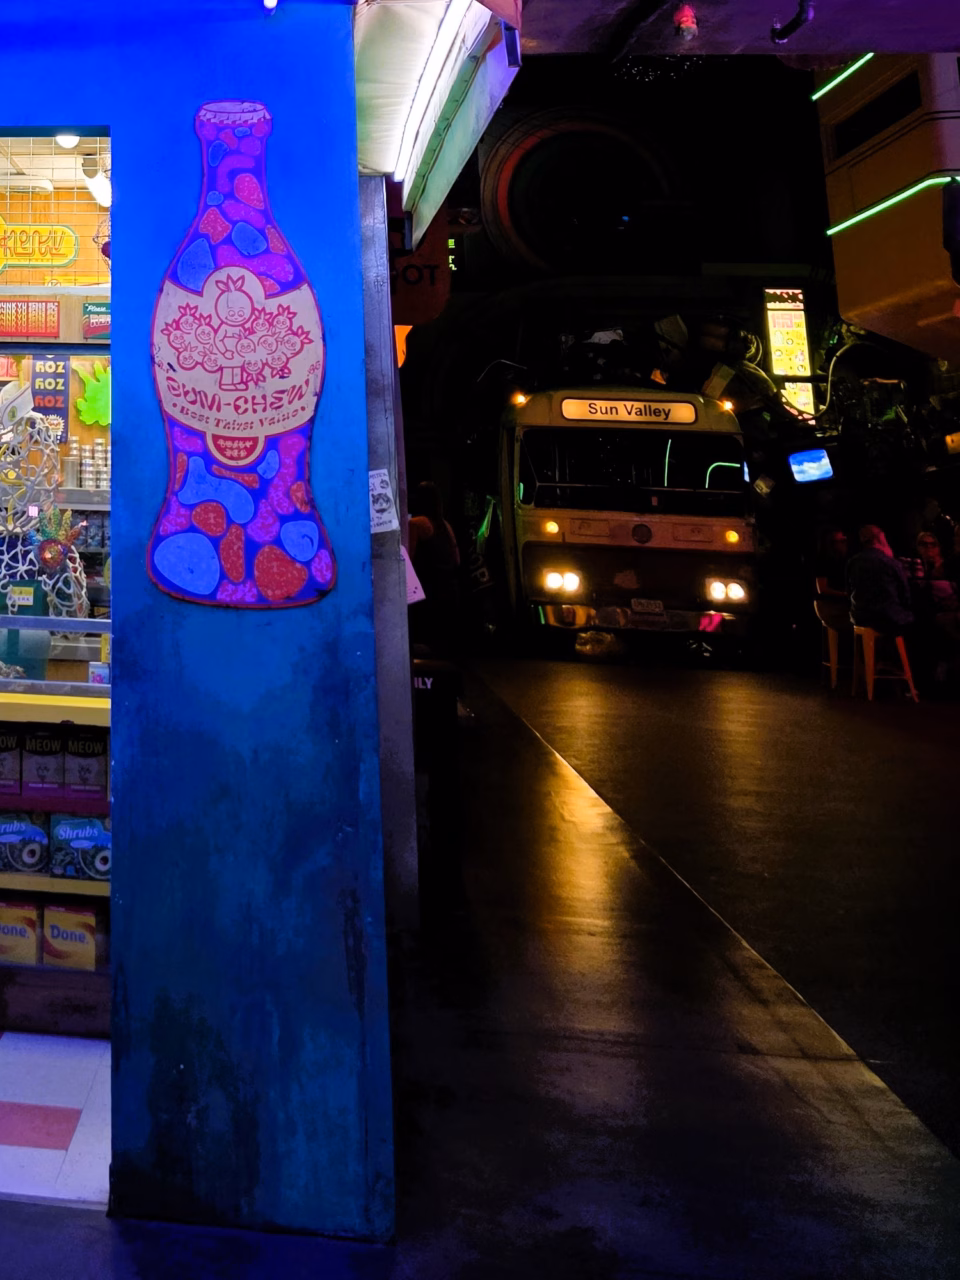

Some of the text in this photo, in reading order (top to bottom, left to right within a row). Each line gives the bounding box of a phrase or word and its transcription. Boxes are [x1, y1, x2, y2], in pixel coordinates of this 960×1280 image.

[588, 403, 671, 420] Sun Valley
[26, 739, 62, 752] MEOW
[68, 741, 104, 754] MEOW
[58, 826, 99, 840] Shrubs
